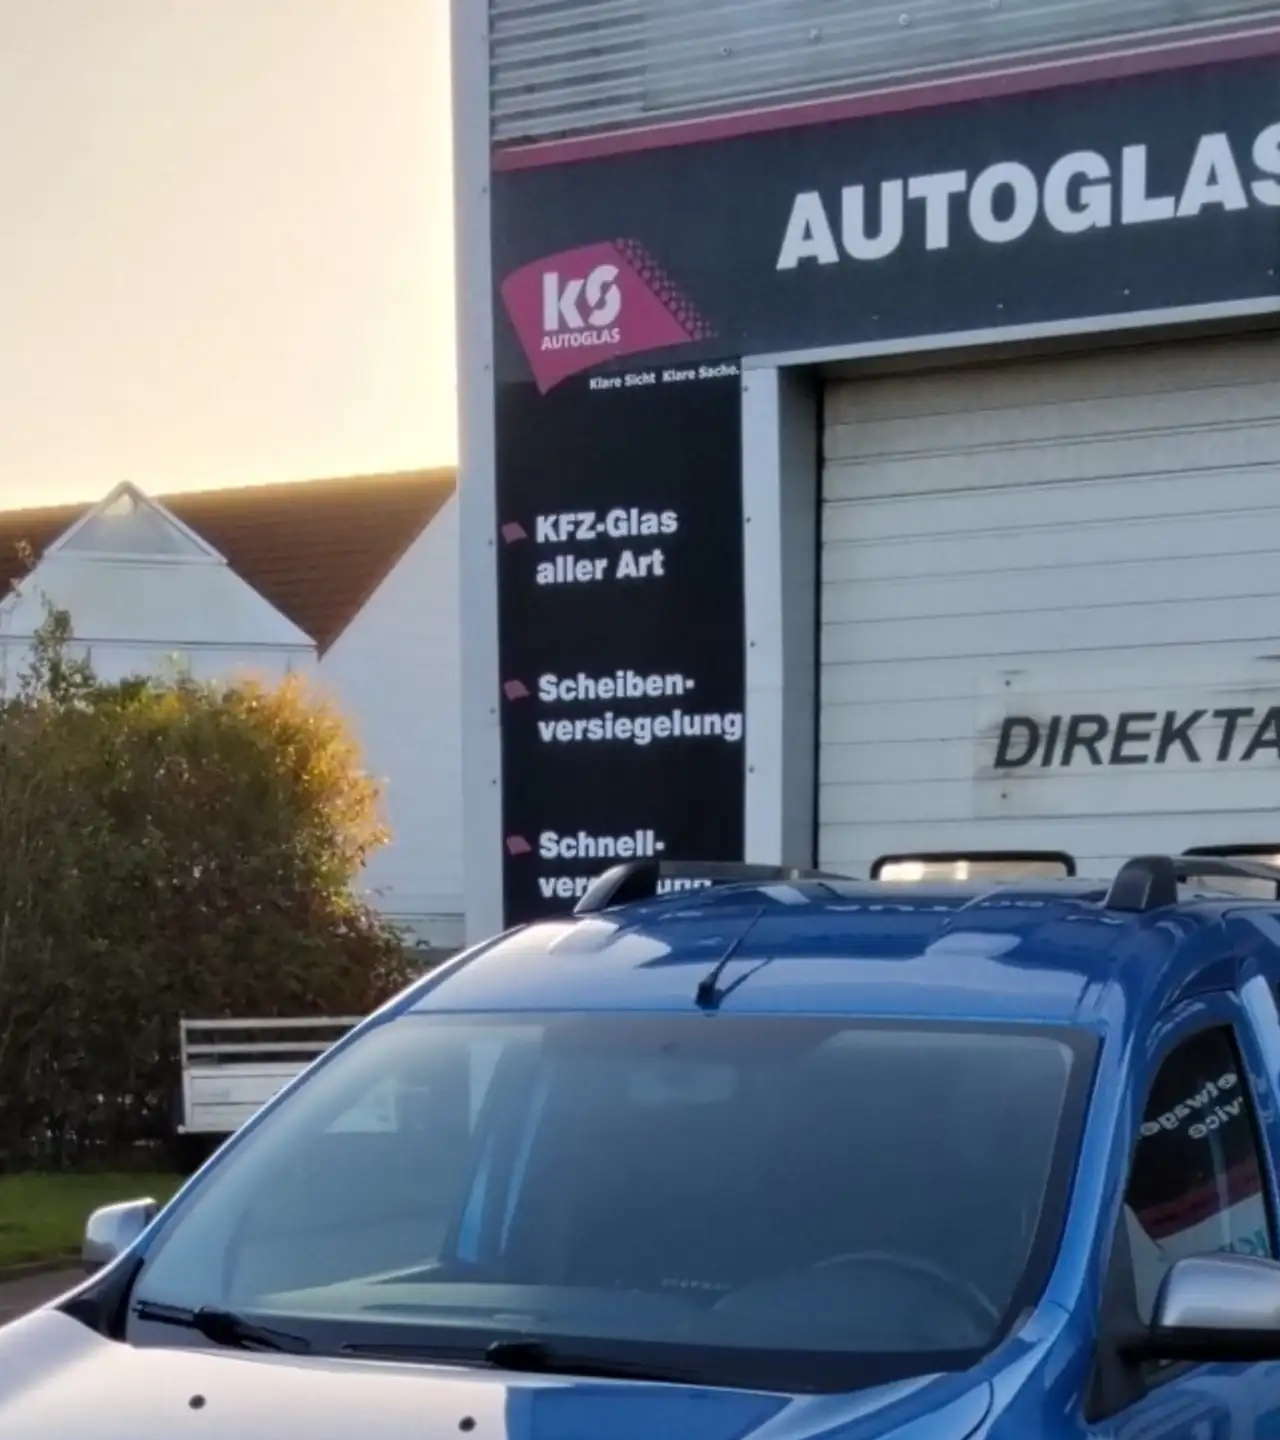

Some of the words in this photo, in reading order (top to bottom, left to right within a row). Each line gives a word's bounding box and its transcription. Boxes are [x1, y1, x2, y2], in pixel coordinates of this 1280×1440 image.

[540, 327, 621, 351] AUTOGLAS
[589, 375, 621, 390] Klare
[661, 367, 697, 383] Klare
[698, 363, 740, 380] Sache.
[535, 507, 679, 544] KFZ-Glas
[535, 553, 609, 585] aller
[615, 548, 666, 579] Art
[537, 669, 696, 702] Scheiben-
[536, 708, 744, 745] versiegelung
[538, 829, 666, 860] Schnell-
